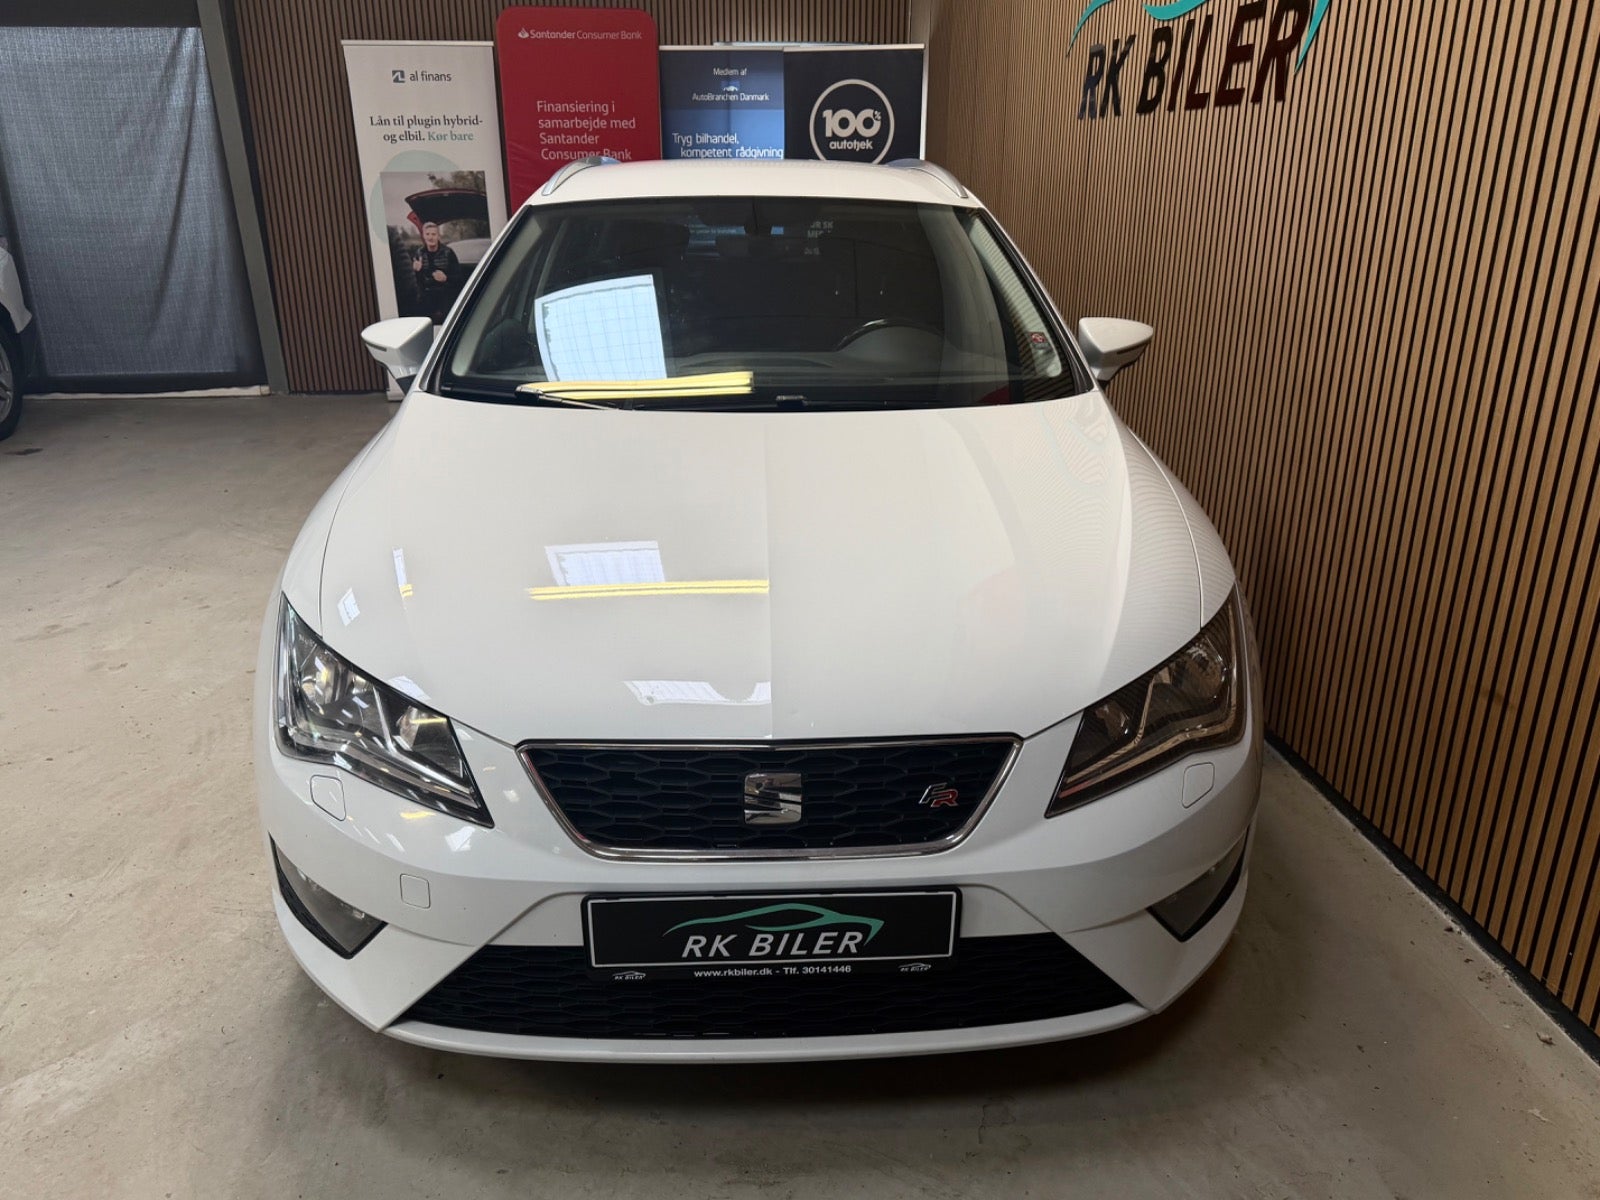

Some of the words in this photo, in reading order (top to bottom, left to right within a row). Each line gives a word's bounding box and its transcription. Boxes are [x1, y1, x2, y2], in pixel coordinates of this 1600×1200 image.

[530, 29, 575, 39] Santander
[576, 30, 619, 40] Consumer
[620, 30, 642, 40] Bank
[1077, 34, 1137, 120] RK
[1136, 0, 1311, 115] BILER
[409, 70, 419, 82] al
[421, 70, 452, 82] finans
[713, 68, 739, 76] Medlem
[740, 68, 748, 76] af
[692, 93, 738, 101] AutoBranchen
[740, 93, 770, 101] Danmark
[536, 100, 609, 116] Finansiering
[612, 101, 615, 113] i
[370, 115, 391, 127] Lån
[393, 115, 404, 127] til
[407, 115, 441, 129] plugin
[443, 115, 483, 128] hybrid-
[538, 117, 607, 132] samarbejde
[610, 118, 636, 130] med
[383, 134, 398, 144] og
[399, 130, 425, 142] elbil.
[428, 131, 448, 142] Kør
[450, 130, 474, 142] bare
[539, 132, 600, 145] Santander
[672, 133, 693, 147] Tryg
[829, 139, 874, 152] autotjek
[541, 148, 600, 160] Consumer
[602, 148, 632, 160] Bank
[681, 148, 733, 160] kompetent
[735, 146, 785, 160] rådgivning
[919, 783, 958, 807] FR
[681, 934, 738, 958] RK
[748, 931, 863, 956] BILER
[694, 967, 773, 978] www.rkbiler.dk
[783, 967, 800, 976] Tlf.
[802, 965, 851, 975] 30141446
